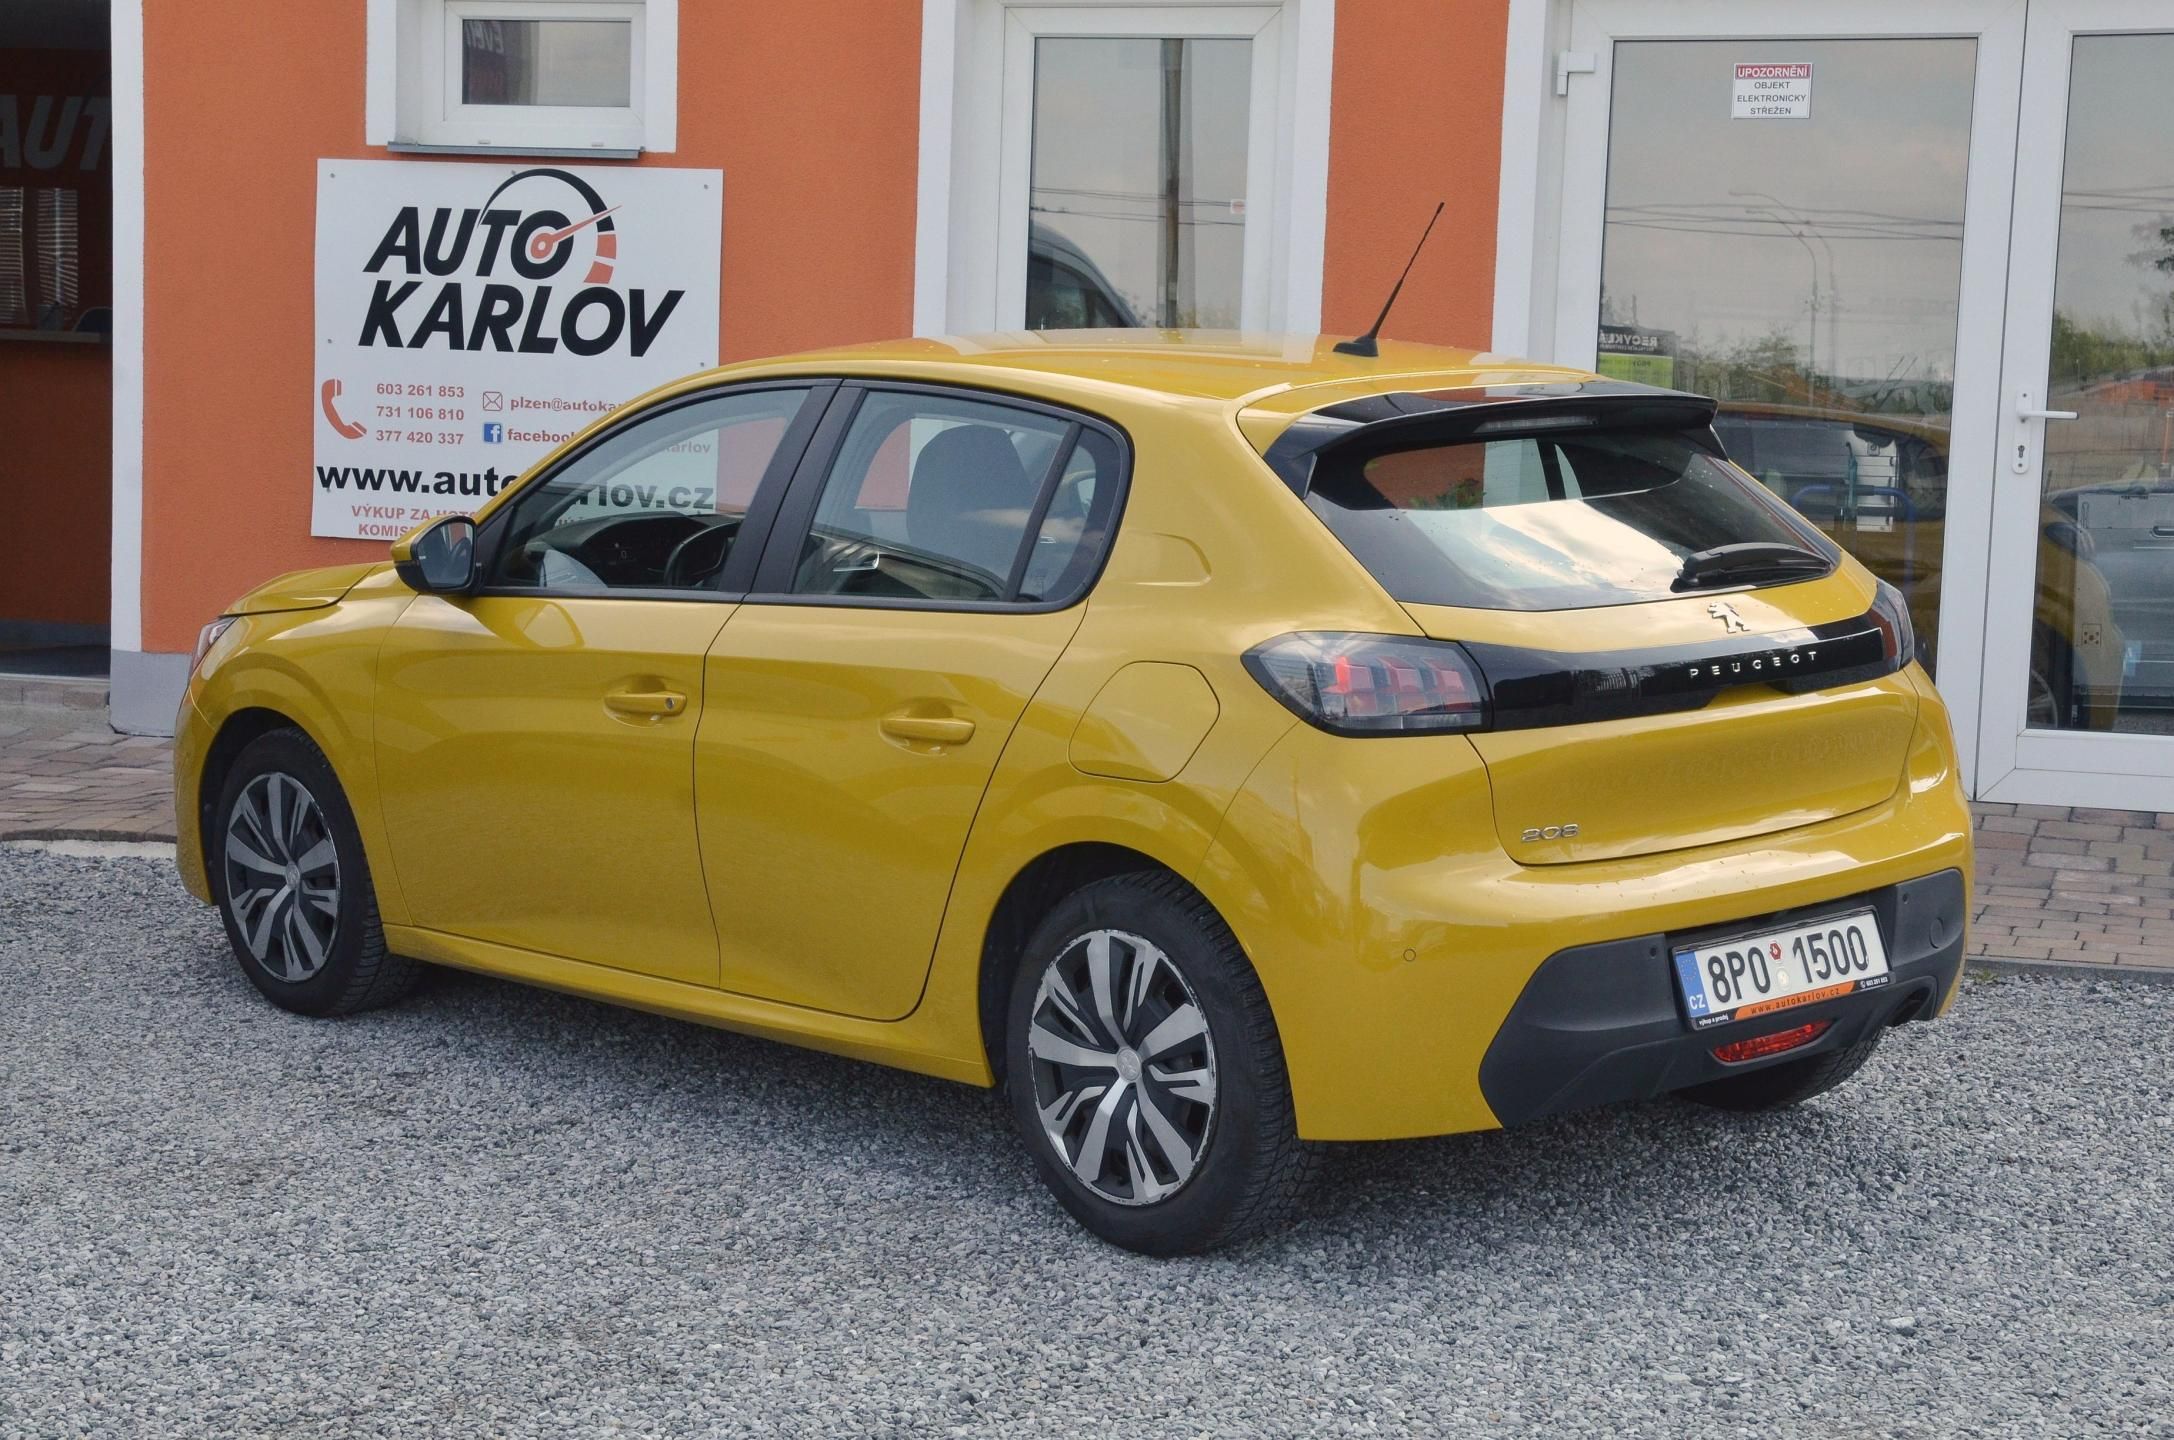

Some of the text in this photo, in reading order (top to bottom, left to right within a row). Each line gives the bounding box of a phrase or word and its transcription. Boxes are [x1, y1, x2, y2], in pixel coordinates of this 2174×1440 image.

[1738, 65, 1808, 77] UPOZORNĚNÍ
[1754, 81, 1791, 89] OBJEKT
[1737, 94, 1806, 102] ELEKTRONICKY
[1750, 106, 1791, 115] STŘEŽEN
[363, 206, 575, 280] AUTO
[358, 280, 686, 358] KARLOV
[377, 383, 464, 398] 603 261 853
[376, 406, 464, 420] 731 106 810
[376, 430, 464, 445] 377 420 337
[351, 503, 405, 518] VÝKUP
[410, 508, 430, 520] ZA
[358, 523, 413, 537] KOMIS
[1689, 651, 1817, 679] PEUGEOT
[1521, 823, 1578, 842] 208
[1792, 925, 1868, 984] 1500
[1689, 993, 1706, 1009] CZ
[1751, 988, 1841, 1014] www.autokarlov.cz
